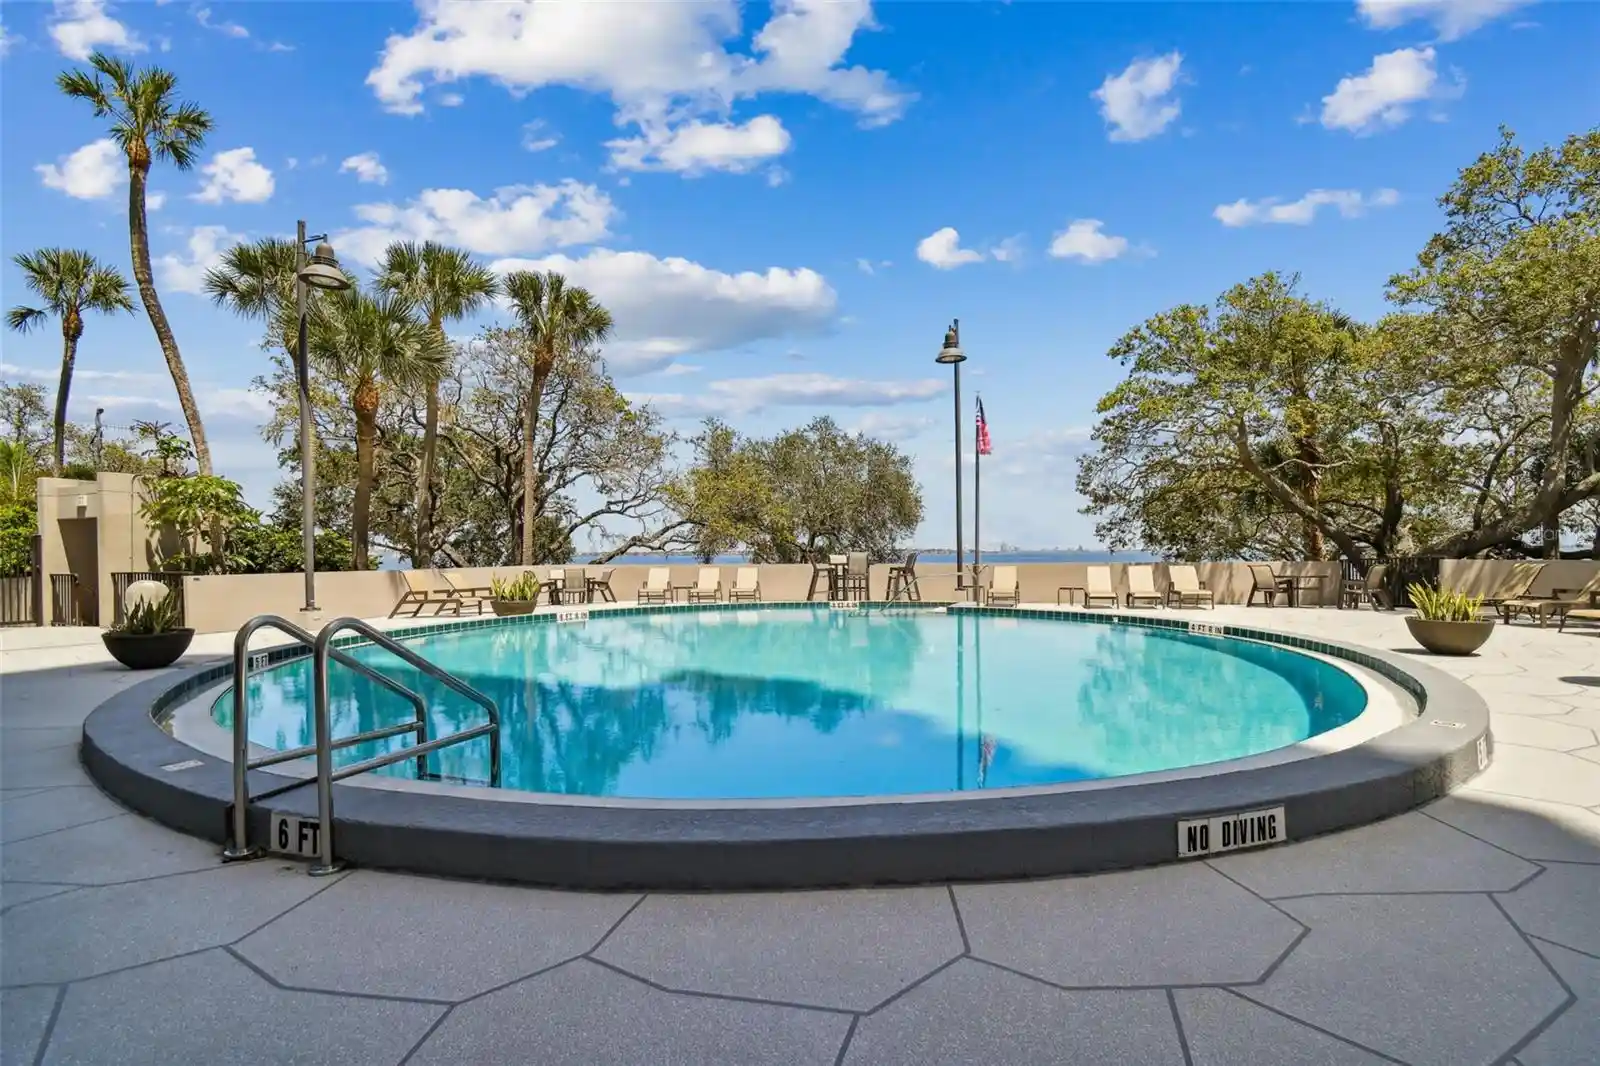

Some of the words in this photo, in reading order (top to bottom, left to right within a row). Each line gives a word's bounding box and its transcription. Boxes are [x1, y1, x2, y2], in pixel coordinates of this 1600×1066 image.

[279, 818, 289, 850] 6
[298, 821, 321, 855] FT
[1187, 824, 1209, 852] NO
[1222, 814, 1276, 848] DIVING
